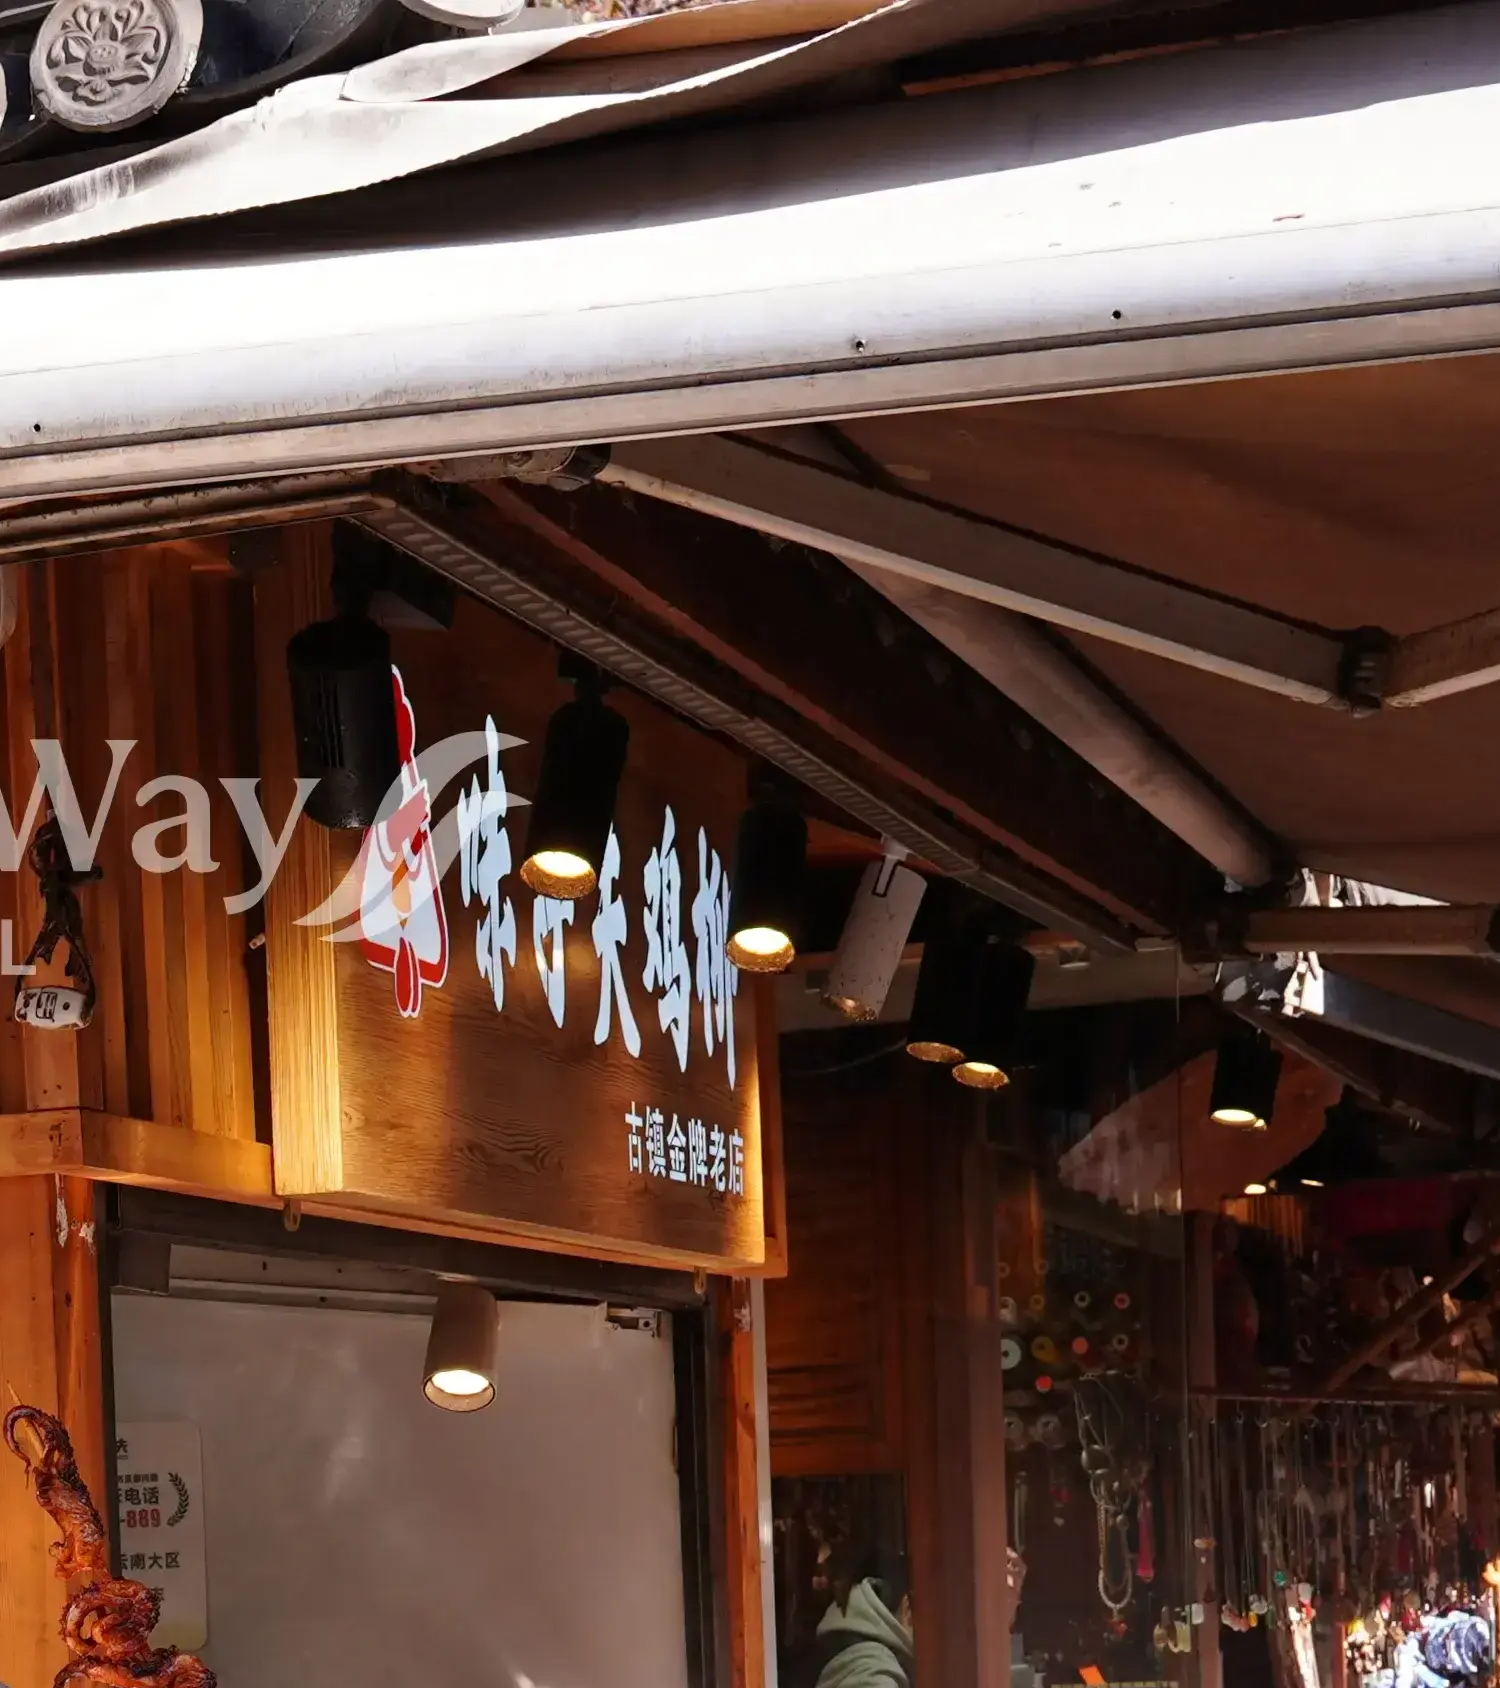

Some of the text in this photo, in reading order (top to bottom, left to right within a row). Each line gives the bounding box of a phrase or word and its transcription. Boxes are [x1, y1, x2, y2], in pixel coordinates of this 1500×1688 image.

[625, 1100, 744, 1197] 古镇金牌老店
[120, 1552, 180, 1570] 云南大区
